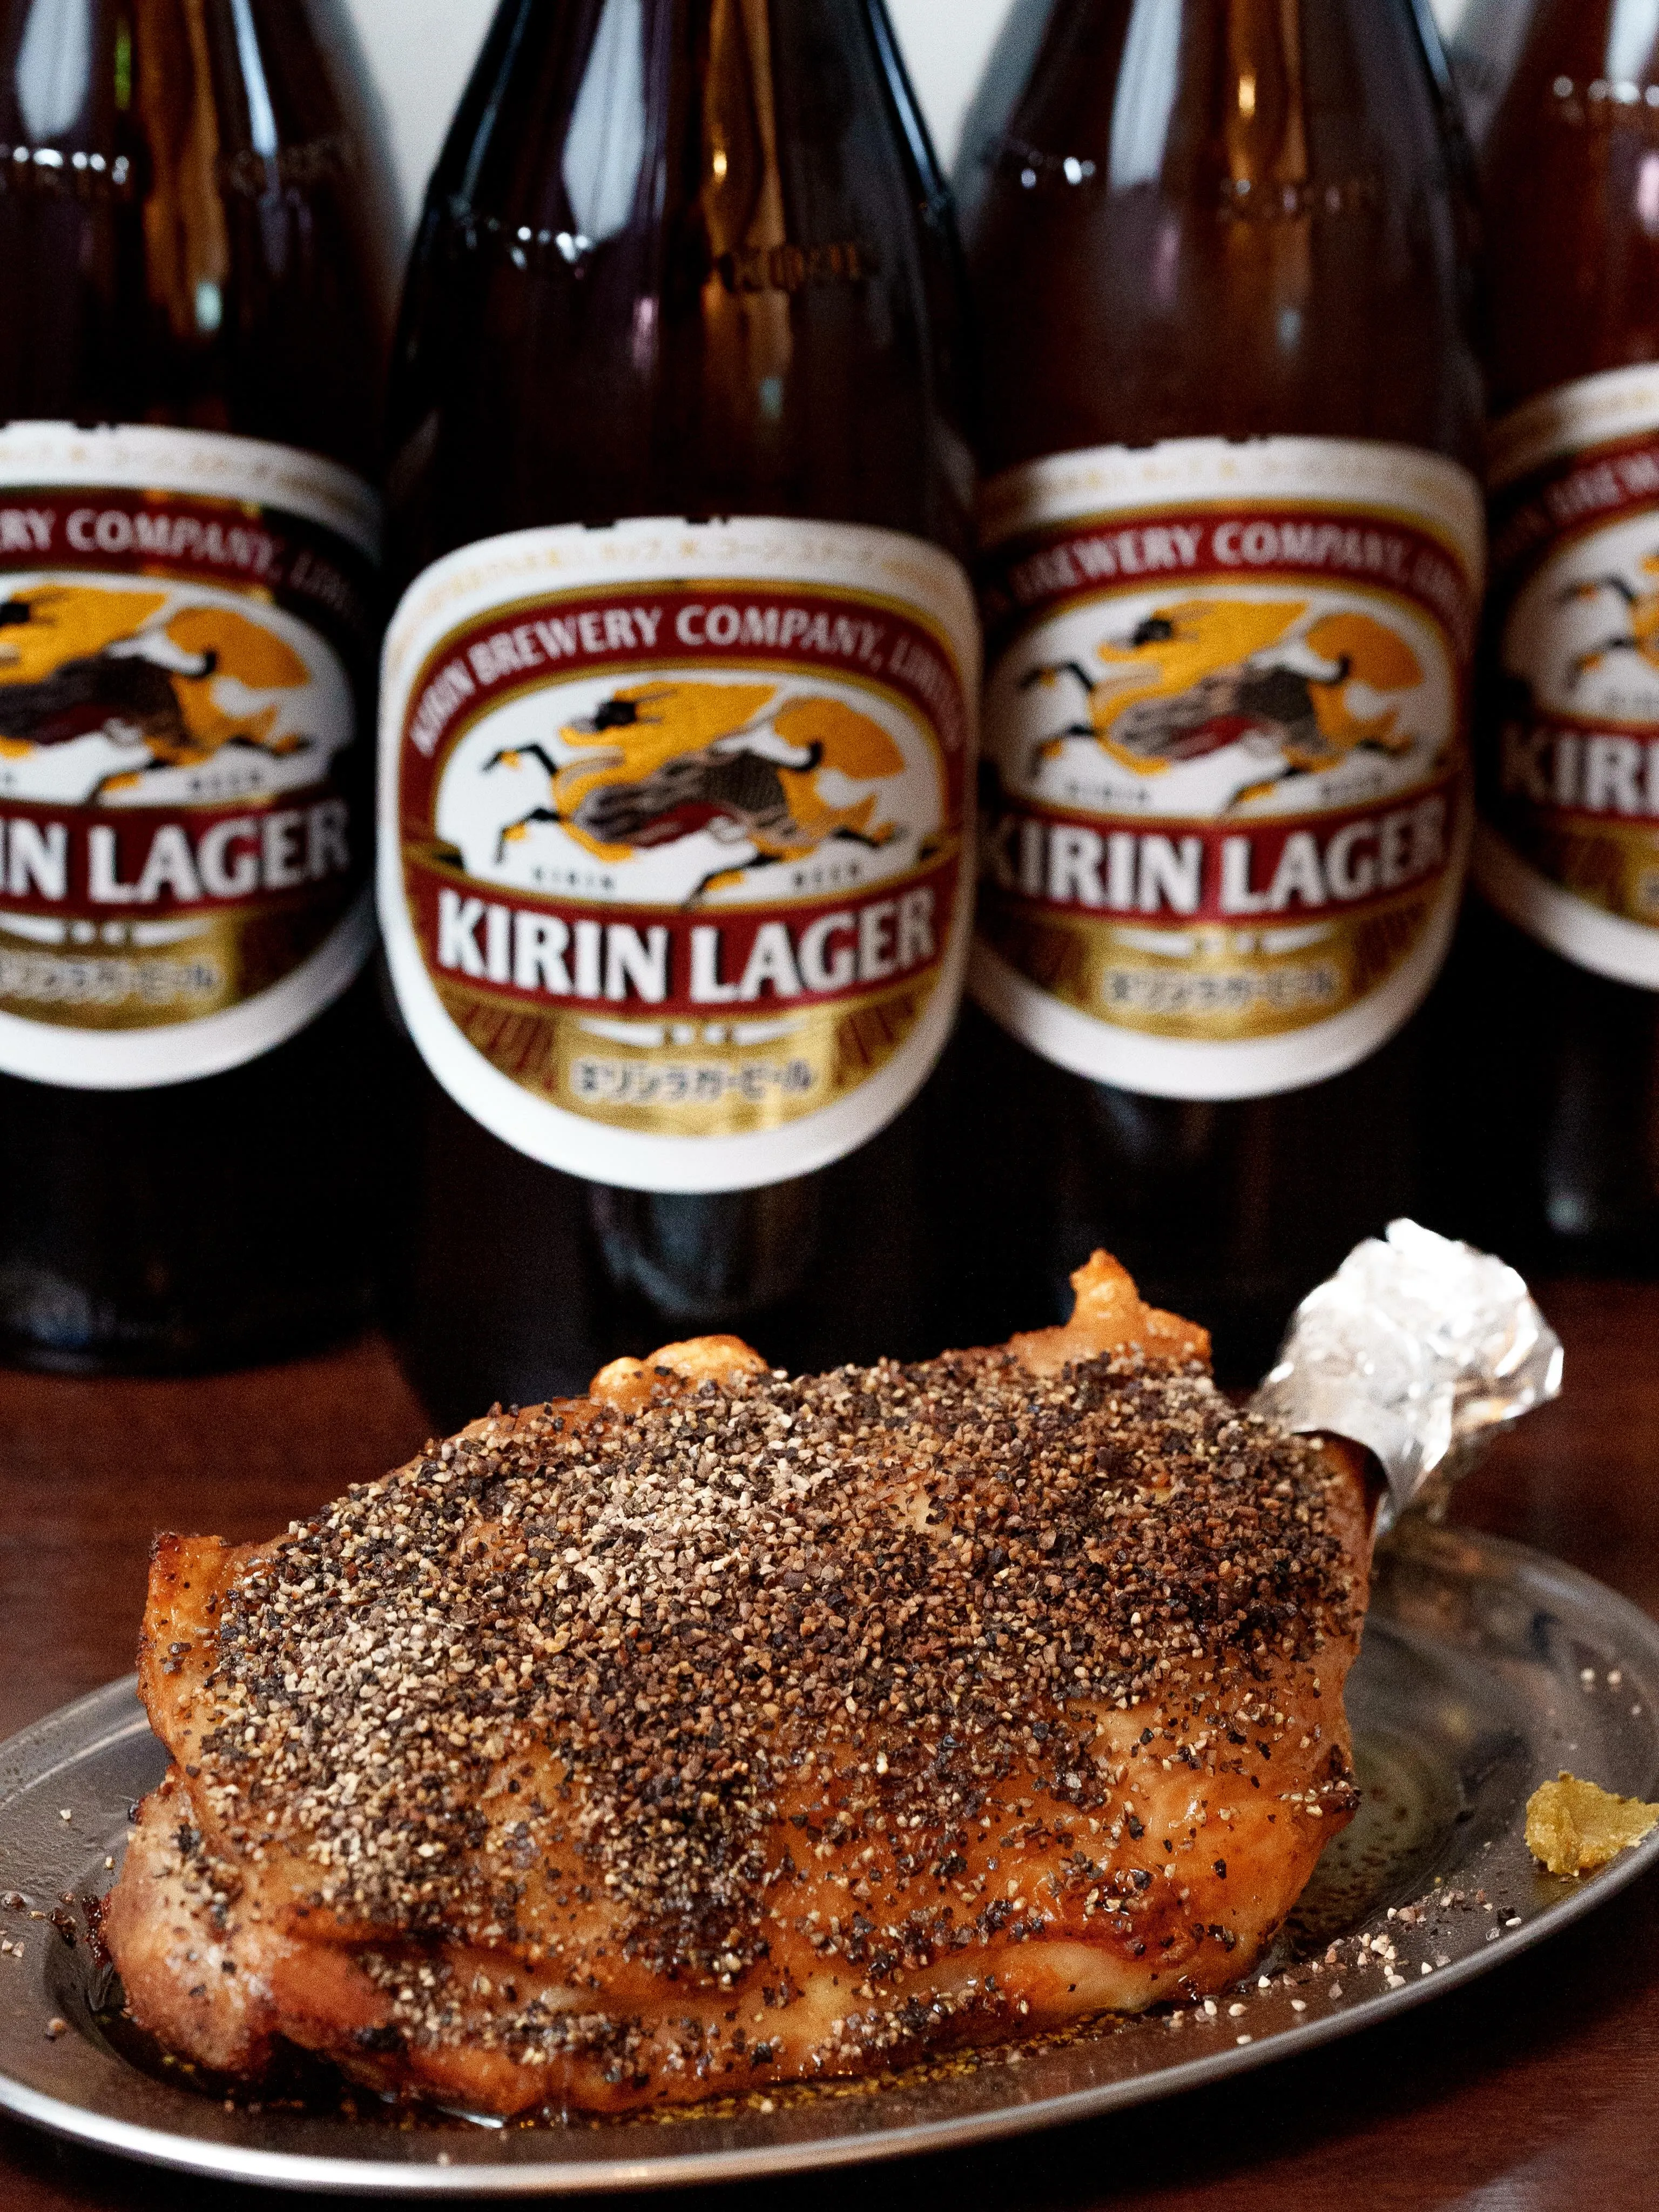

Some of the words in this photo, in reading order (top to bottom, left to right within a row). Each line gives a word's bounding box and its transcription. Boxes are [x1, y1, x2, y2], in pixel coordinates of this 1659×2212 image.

[468, 606, 663, 686] BREWERY
[675, 604, 887, 672] COMPANY,
[87, 797, 351, 905] LAGER
[976, 810, 1203, 915] KIRIN
[1219, 795, 1447, 915] LAGER
[436, 887, 669, 1004] KIRIN
[690, 886, 938, 1004] LAGER
